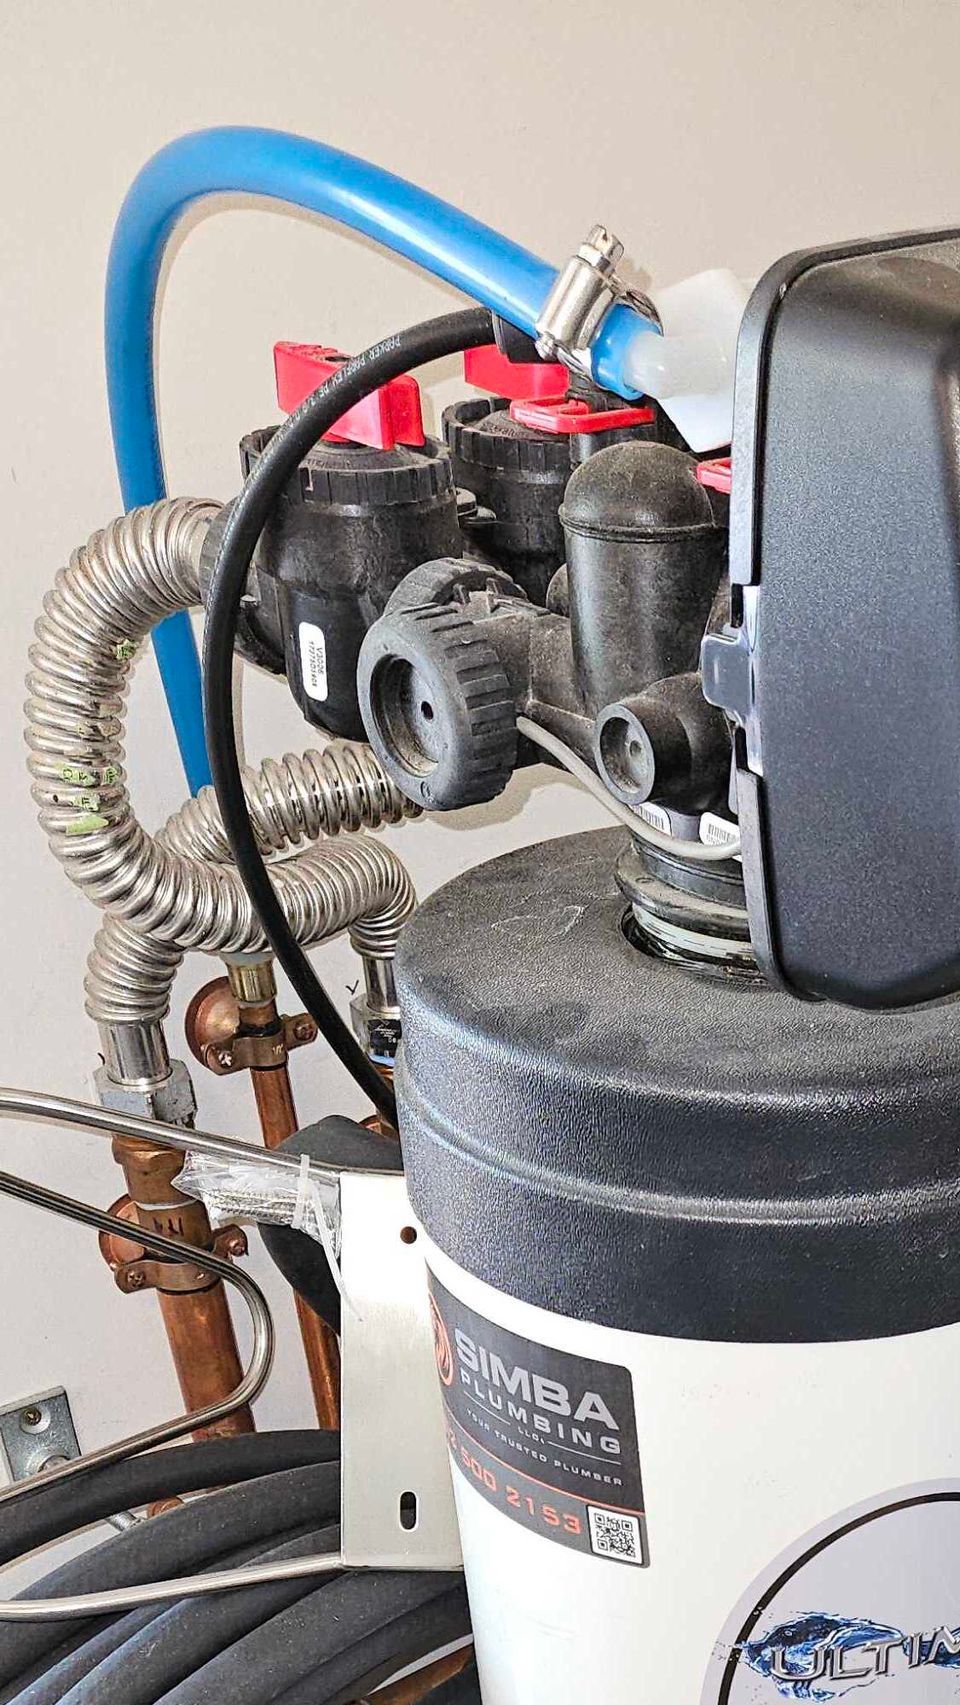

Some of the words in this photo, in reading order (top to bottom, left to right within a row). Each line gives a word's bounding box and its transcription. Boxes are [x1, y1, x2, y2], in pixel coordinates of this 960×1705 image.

[454, 1328, 620, 1431] SIMBA
[460, 1368, 621, 1455] PLUMBING
[461, 1447, 497, 1493] 500
[506, 1485, 581, 1535] 2153
[467, 1409, 490, 1432] YOUR
[495, 1431, 547, 1463] TRUSTED
[554, 1460, 623, 1486] PLUMBER
